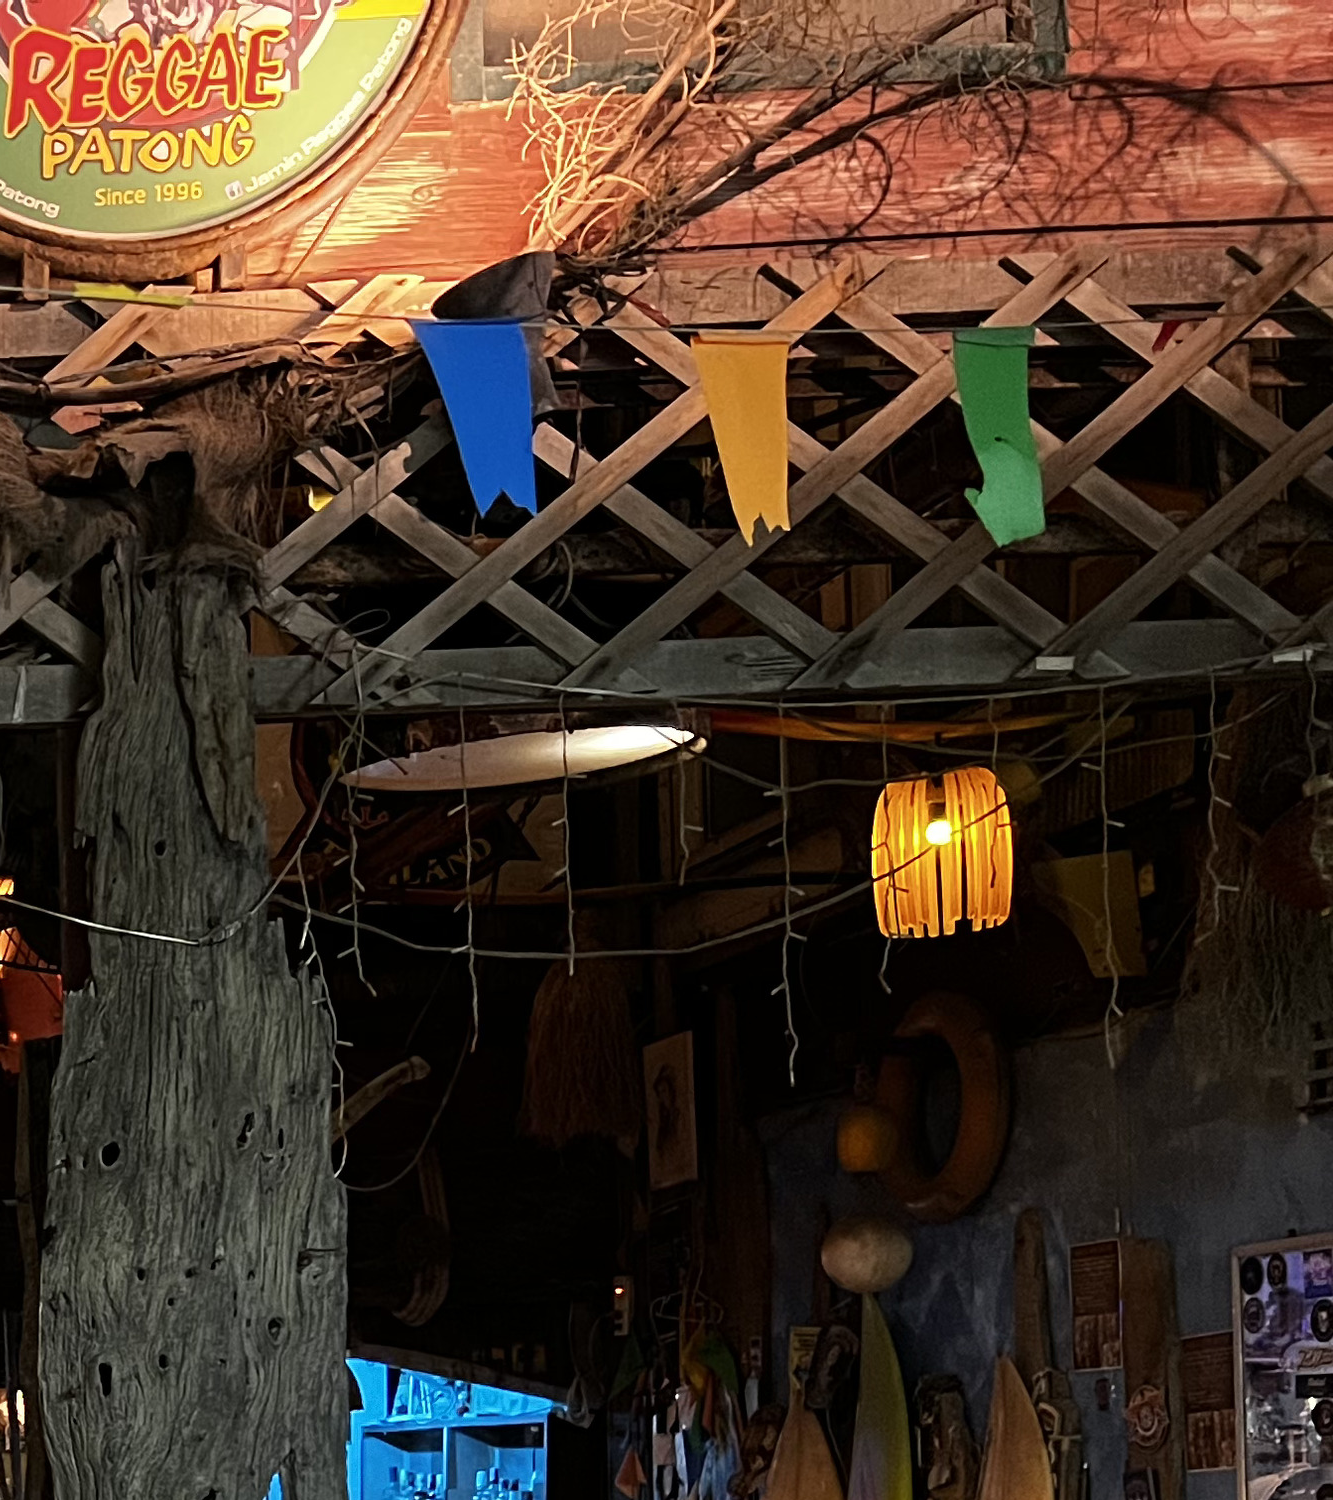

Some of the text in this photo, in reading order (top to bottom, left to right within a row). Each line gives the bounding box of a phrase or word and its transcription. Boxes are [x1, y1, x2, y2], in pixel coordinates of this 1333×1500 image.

[4, 26, 289, 138] REGGAE
[244, 152, 303, 193] Jamin
[359, 17, 413, 92] Patong
[41, 114, 257, 180] PATONG
[94, 181, 203, 207] Since 1996
